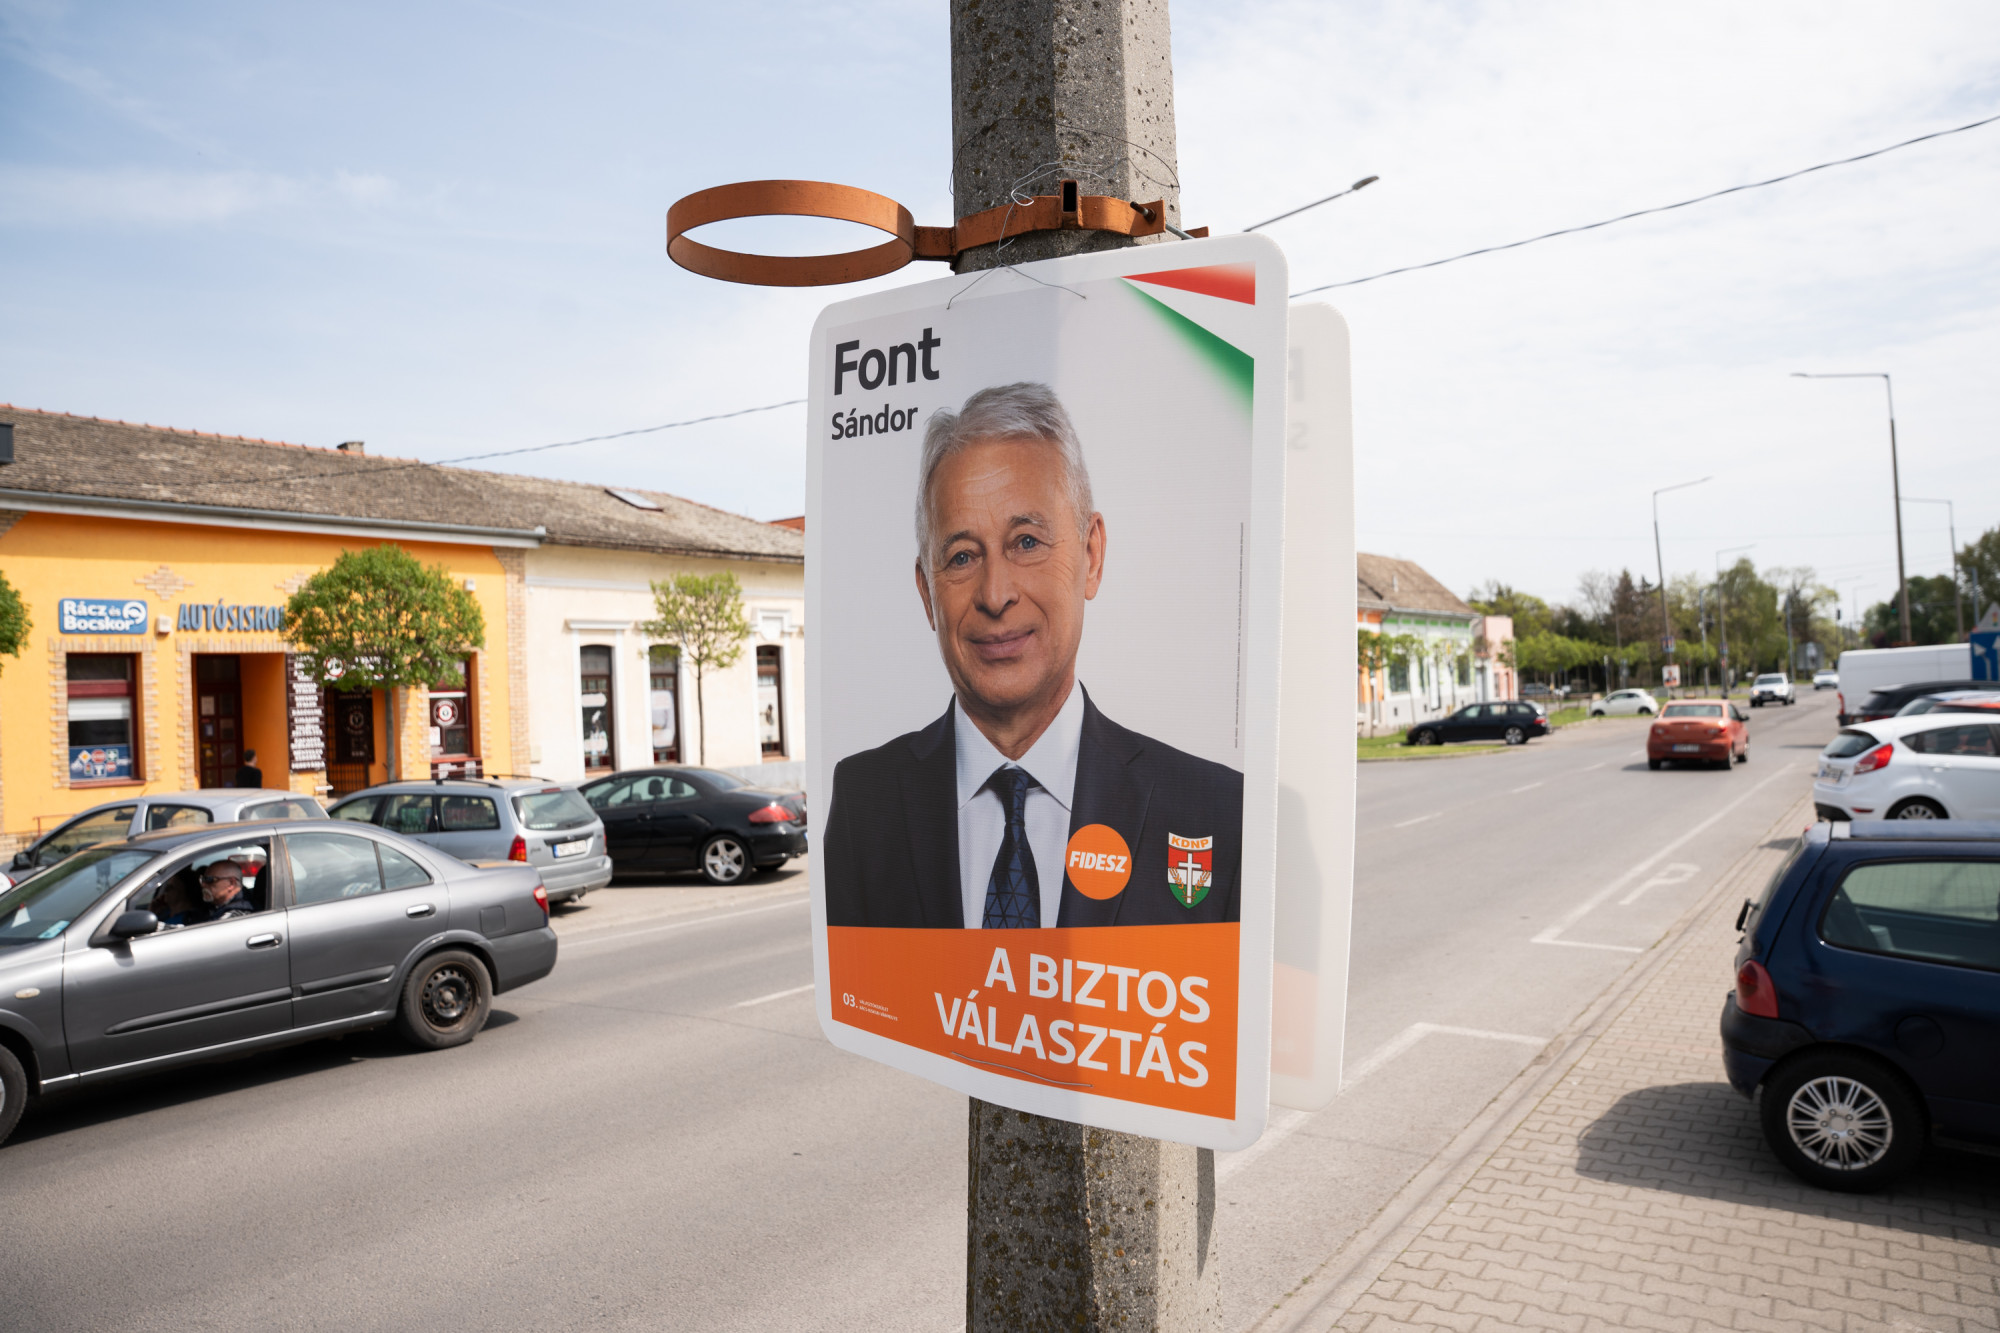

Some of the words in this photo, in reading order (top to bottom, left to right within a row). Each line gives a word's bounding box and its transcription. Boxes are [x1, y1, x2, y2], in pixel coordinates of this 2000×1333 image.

[834, 327, 941, 396] Font
[831, 403, 919, 440] Sándor
[63, 600, 107, 616] Rácz
[108, 606, 121, 617] és
[63, 615, 134, 631] Bocskor
[1171, 836, 1209, 849] KDNP
[1069, 850, 1128, 873] FIDESZ
[984, 946, 1017, 993] A
[1028, 952, 1211, 1023] BIZTOS
[843, 992, 859, 1009] 03.
[934, 989, 1210, 1088] VÁLASZTÁS
